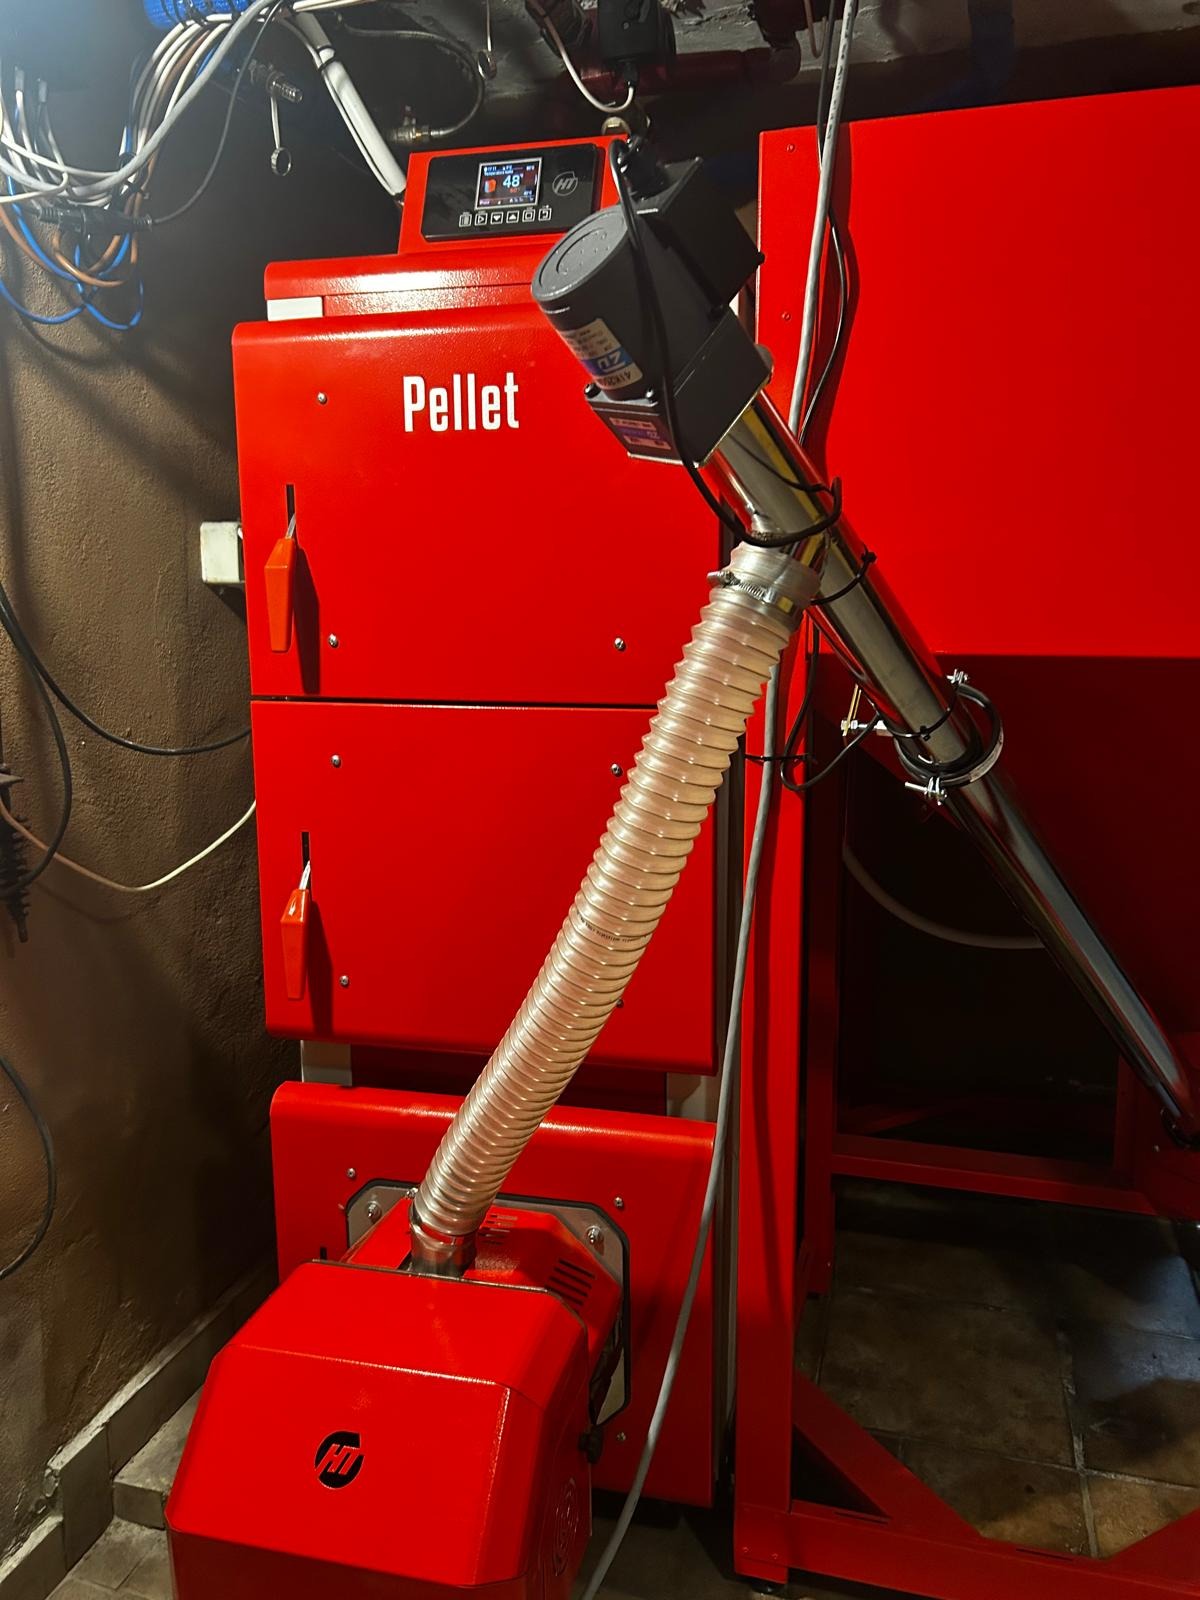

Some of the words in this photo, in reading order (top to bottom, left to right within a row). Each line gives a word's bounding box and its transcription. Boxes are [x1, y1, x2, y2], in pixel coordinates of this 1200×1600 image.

[553, 177, 578, 194] HT
[403, 371, 520, 432] Pellet
[315, 1442, 364, 1479] HT
